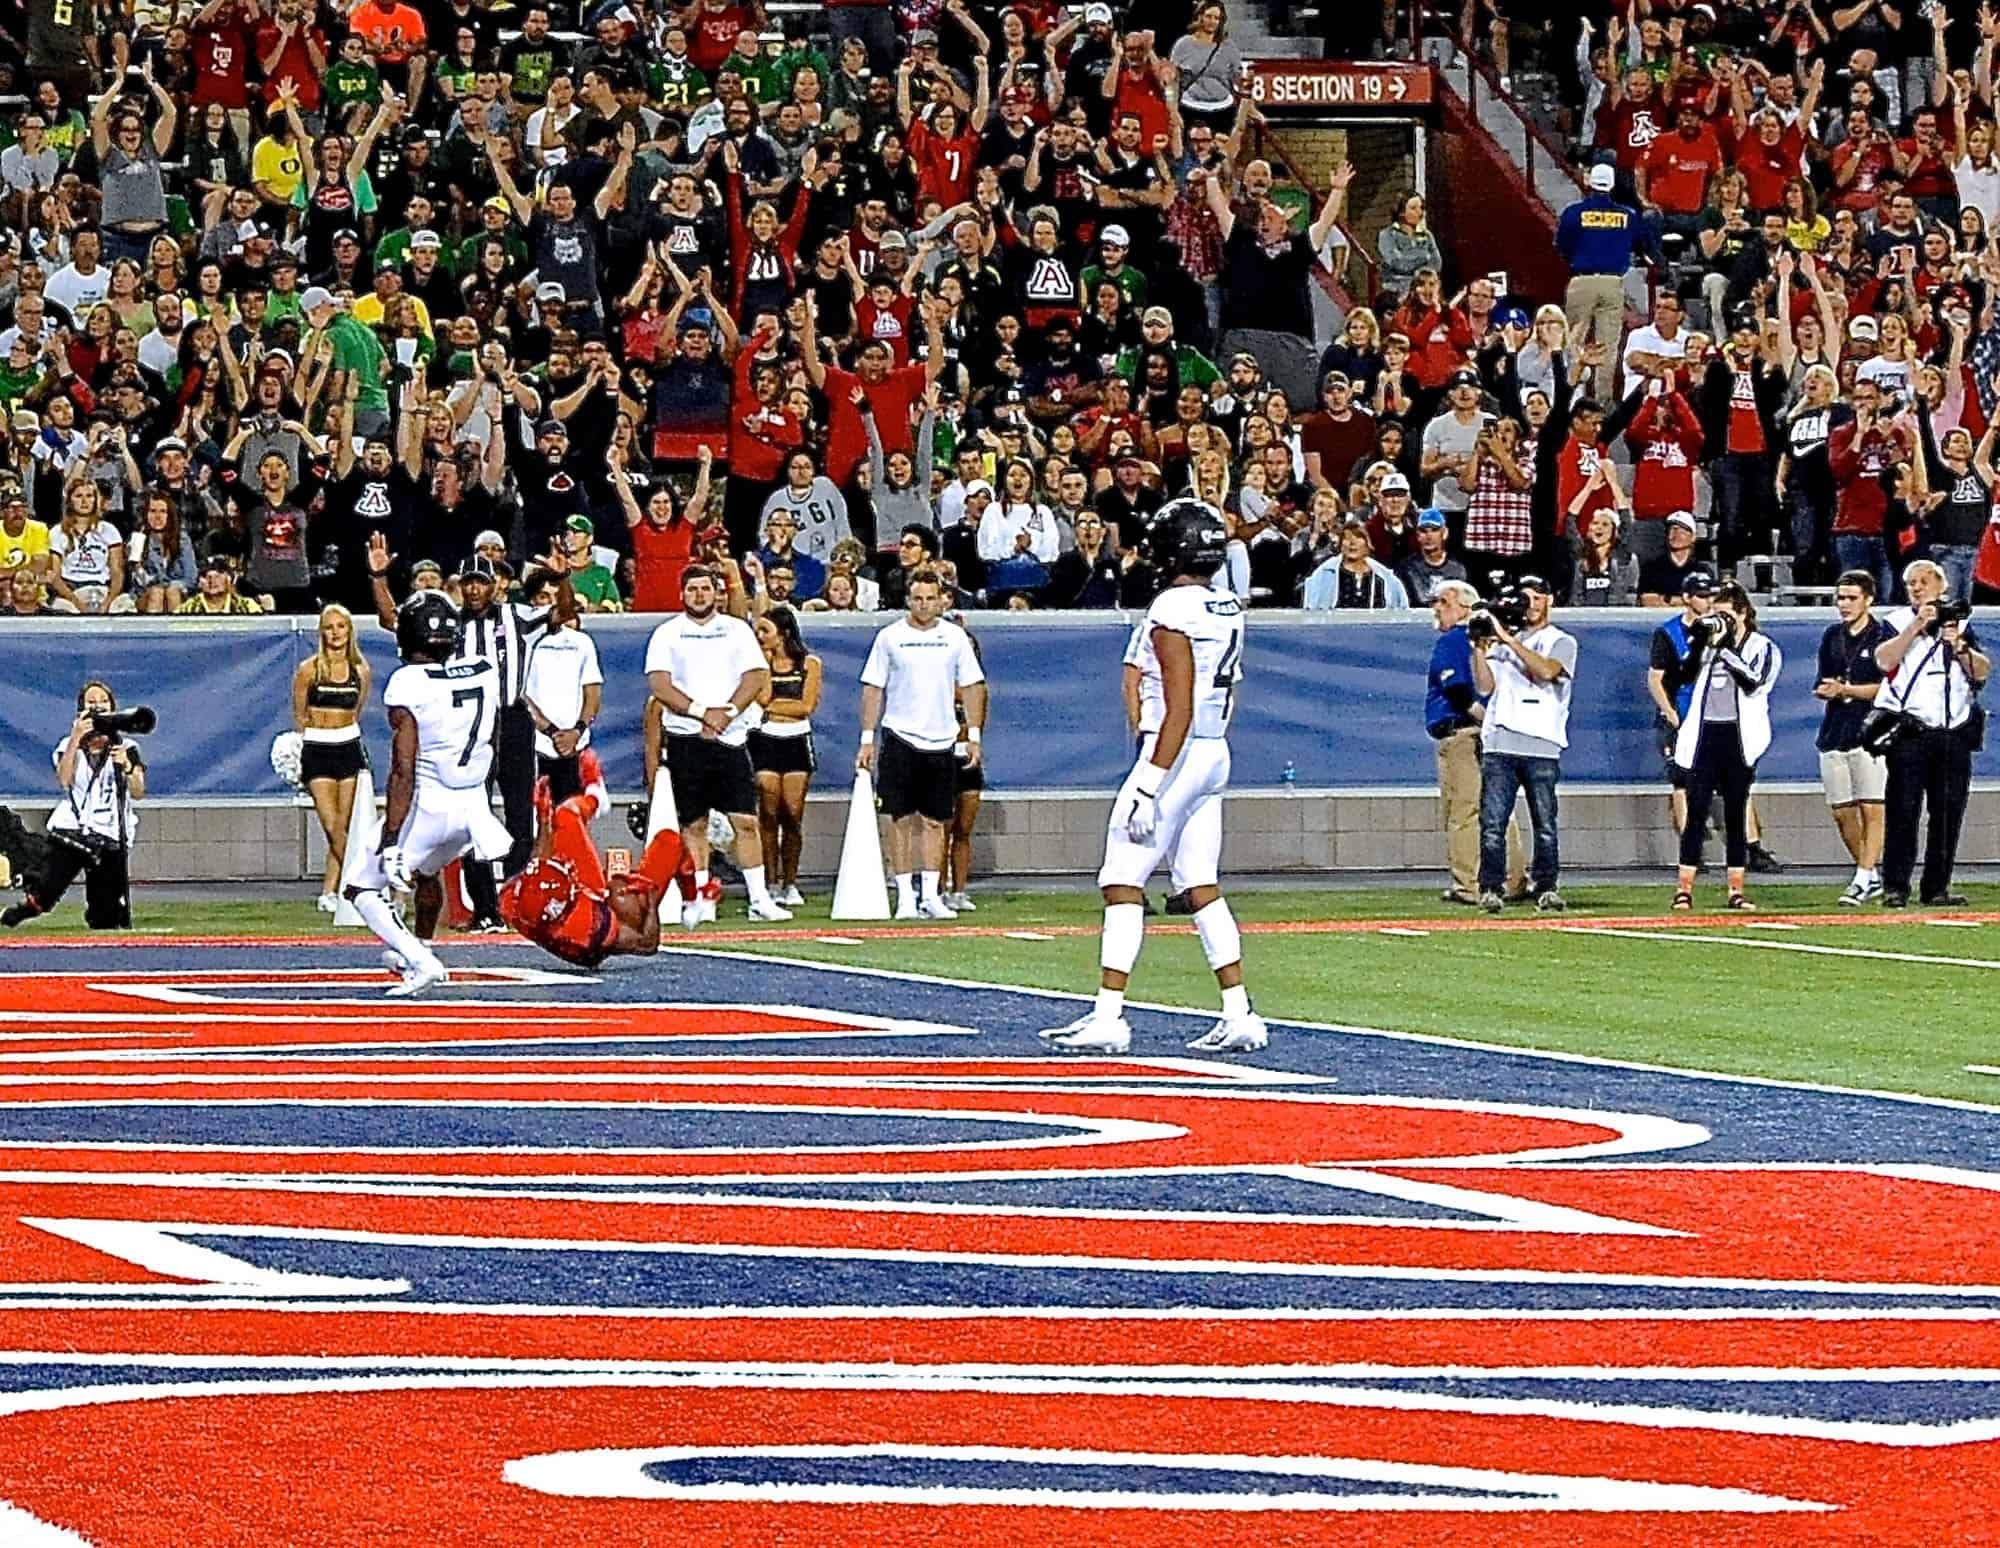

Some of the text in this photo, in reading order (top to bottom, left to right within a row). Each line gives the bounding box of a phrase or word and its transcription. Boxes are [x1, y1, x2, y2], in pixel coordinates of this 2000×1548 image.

[663, 83, 689, 105] 21
[1252, 75, 1382, 101] 8 SECTION 19
[1581, 210, 1628, 229] SECURITY
[671, 225, 699, 253] A
[1027, 257, 1074, 300] A
[354, 482, 393, 517] A
[1952, 475, 1985, 503] A
[1213, 628, 1242, 721] 4
[452, 686, 484, 767] 7
